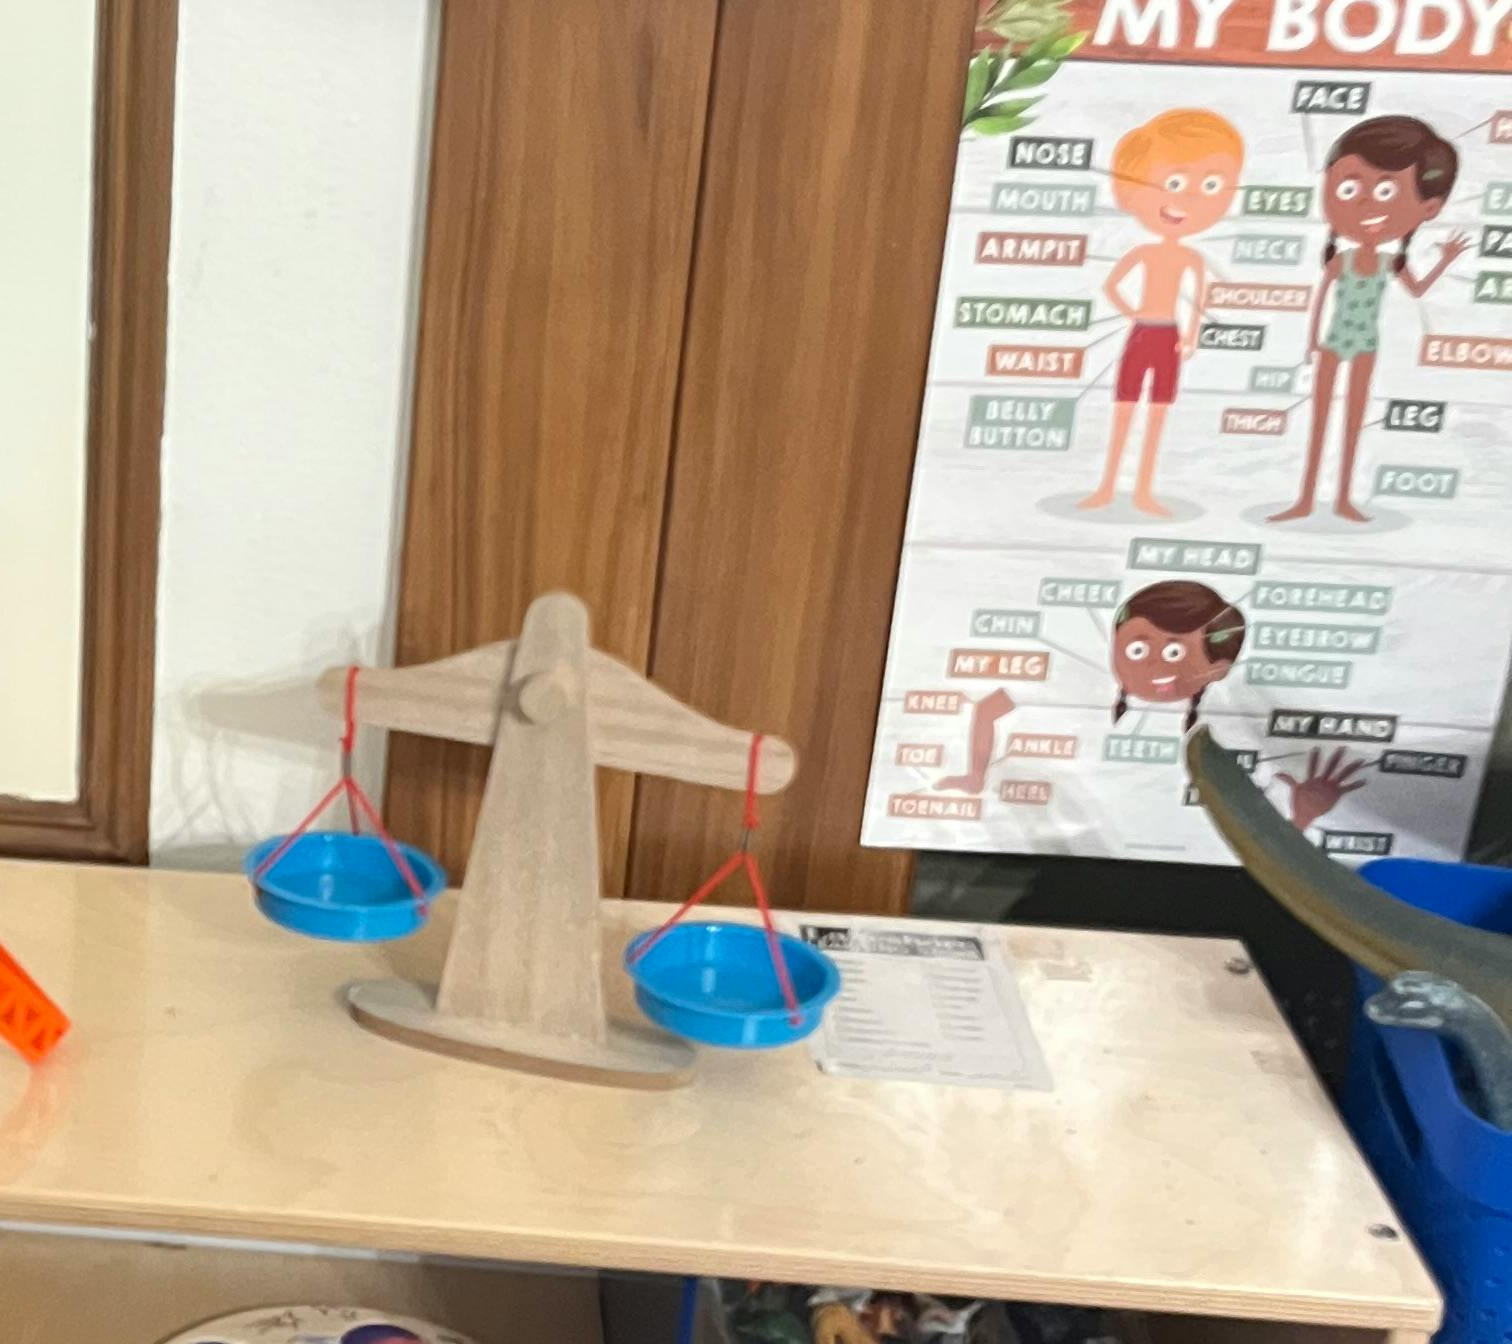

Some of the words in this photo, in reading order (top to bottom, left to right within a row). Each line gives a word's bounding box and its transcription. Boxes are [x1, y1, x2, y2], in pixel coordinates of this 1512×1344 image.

[1295, 87, 1365, 110] FACE
[1014, 142, 1085, 166] NOSE
[996, 188, 1090, 212] MOUTH
[1246, 190, 1308, 211] EYES
[979, 236, 1081, 262] ARMPIT
[1235, 239, 1302, 260] NECK
[1209, 286, 1307, 309] SHOULDER
[958, 302, 1084, 327] STOMACH
[1200, 327, 1263, 347] CHEST
[995, 350, 1076, 372] WAIST
[986, 400, 1056, 422] BELLY
[1224, 412, 1285, 431] THIGH
[1390, 404, 1441, 428] LEG
[969, 426, 1067, 449] BUTTON
[1381, 471, 1453, 493] FOOT
[1137, 545, 1172, 564] MY
[1182, 546, 1256, 568] HEAD
[1041, 582, 1117, 603] CHEEK
[1256, 586, 1387, 610] FOREHEAD
[973, 614, 1035, 635] CHIN
[1258, 626, 1376, 649] EYEBROW
[953, 653, 992, 673] MY
[998, 655, 1045, 676] LEG
[1248, 662, 1346, 685] TONGUE
[906, 693, 960, 712] KNEE
[1273, 714, 1315, 735] MY
[1318, 716, 1394, 739] HAND
[898, 748, 938, 763] TOE
[1008, 736, 1076, 756] ANKLE
[1107, 739, 1177, 759] TEETH
[1000, 782, 1049, 801] HEEL
[890, 798, 978, 818] TOENAIL
